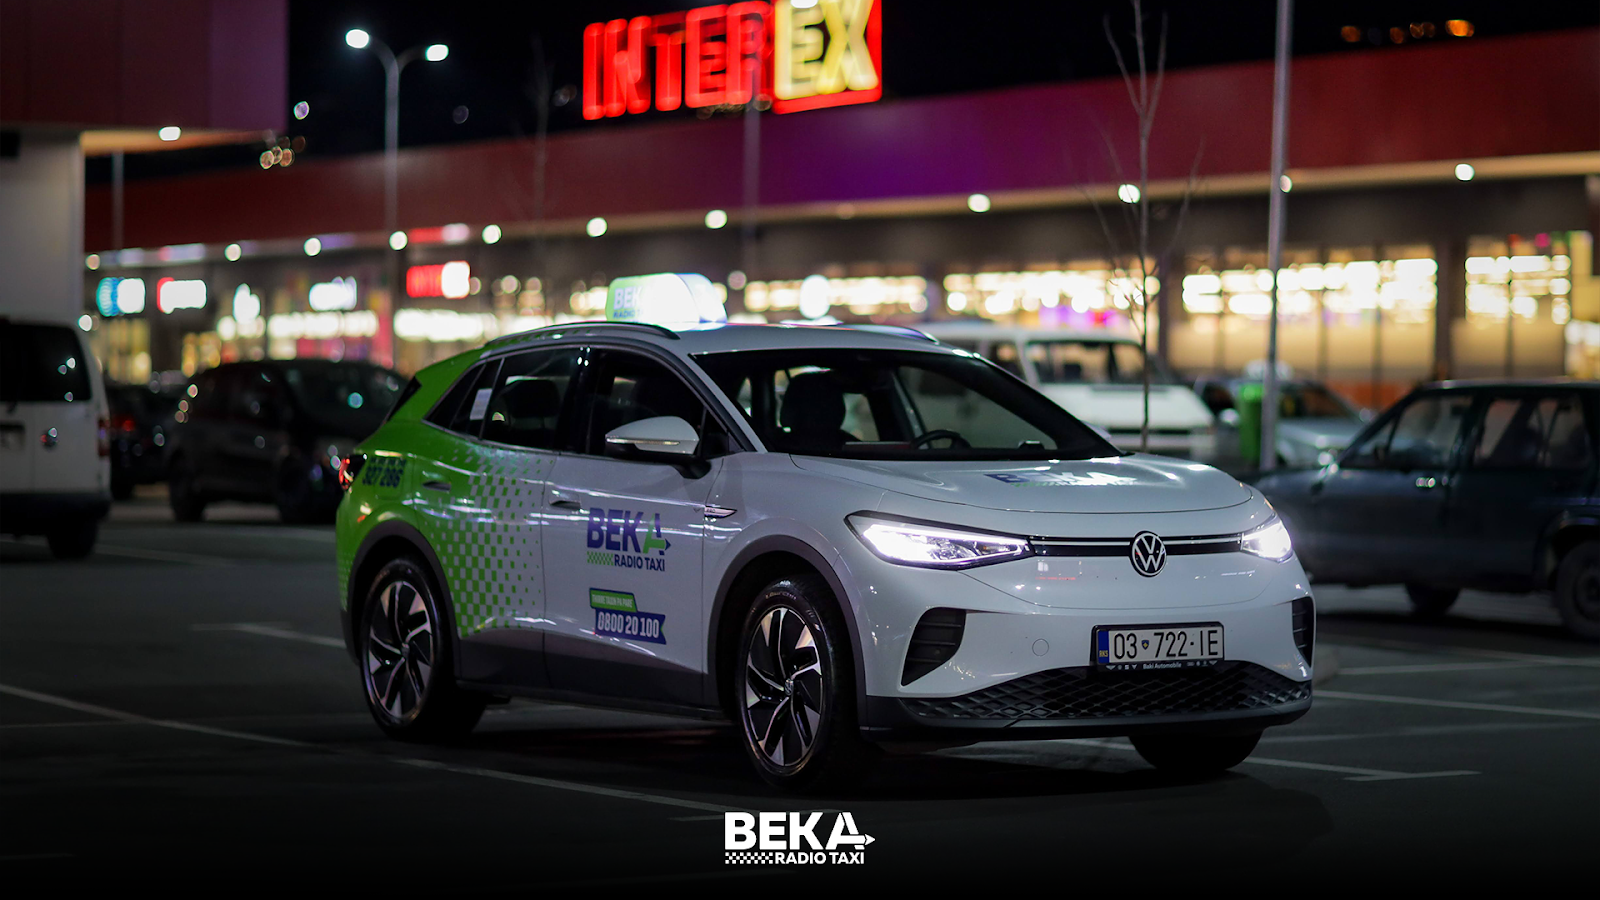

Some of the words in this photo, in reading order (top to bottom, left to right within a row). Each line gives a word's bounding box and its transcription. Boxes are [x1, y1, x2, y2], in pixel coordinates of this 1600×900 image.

[587, 507, 671, 555] BEKA
[614, 553, 643, 569] RADIO
[645, 557, 665, 572] TAXI
[597, 611, 624, 634] 0800
[625, 615, 638, 635] 20
[640, 617, 660, 638] 100
[1114, 633, 1137, 659] 03
